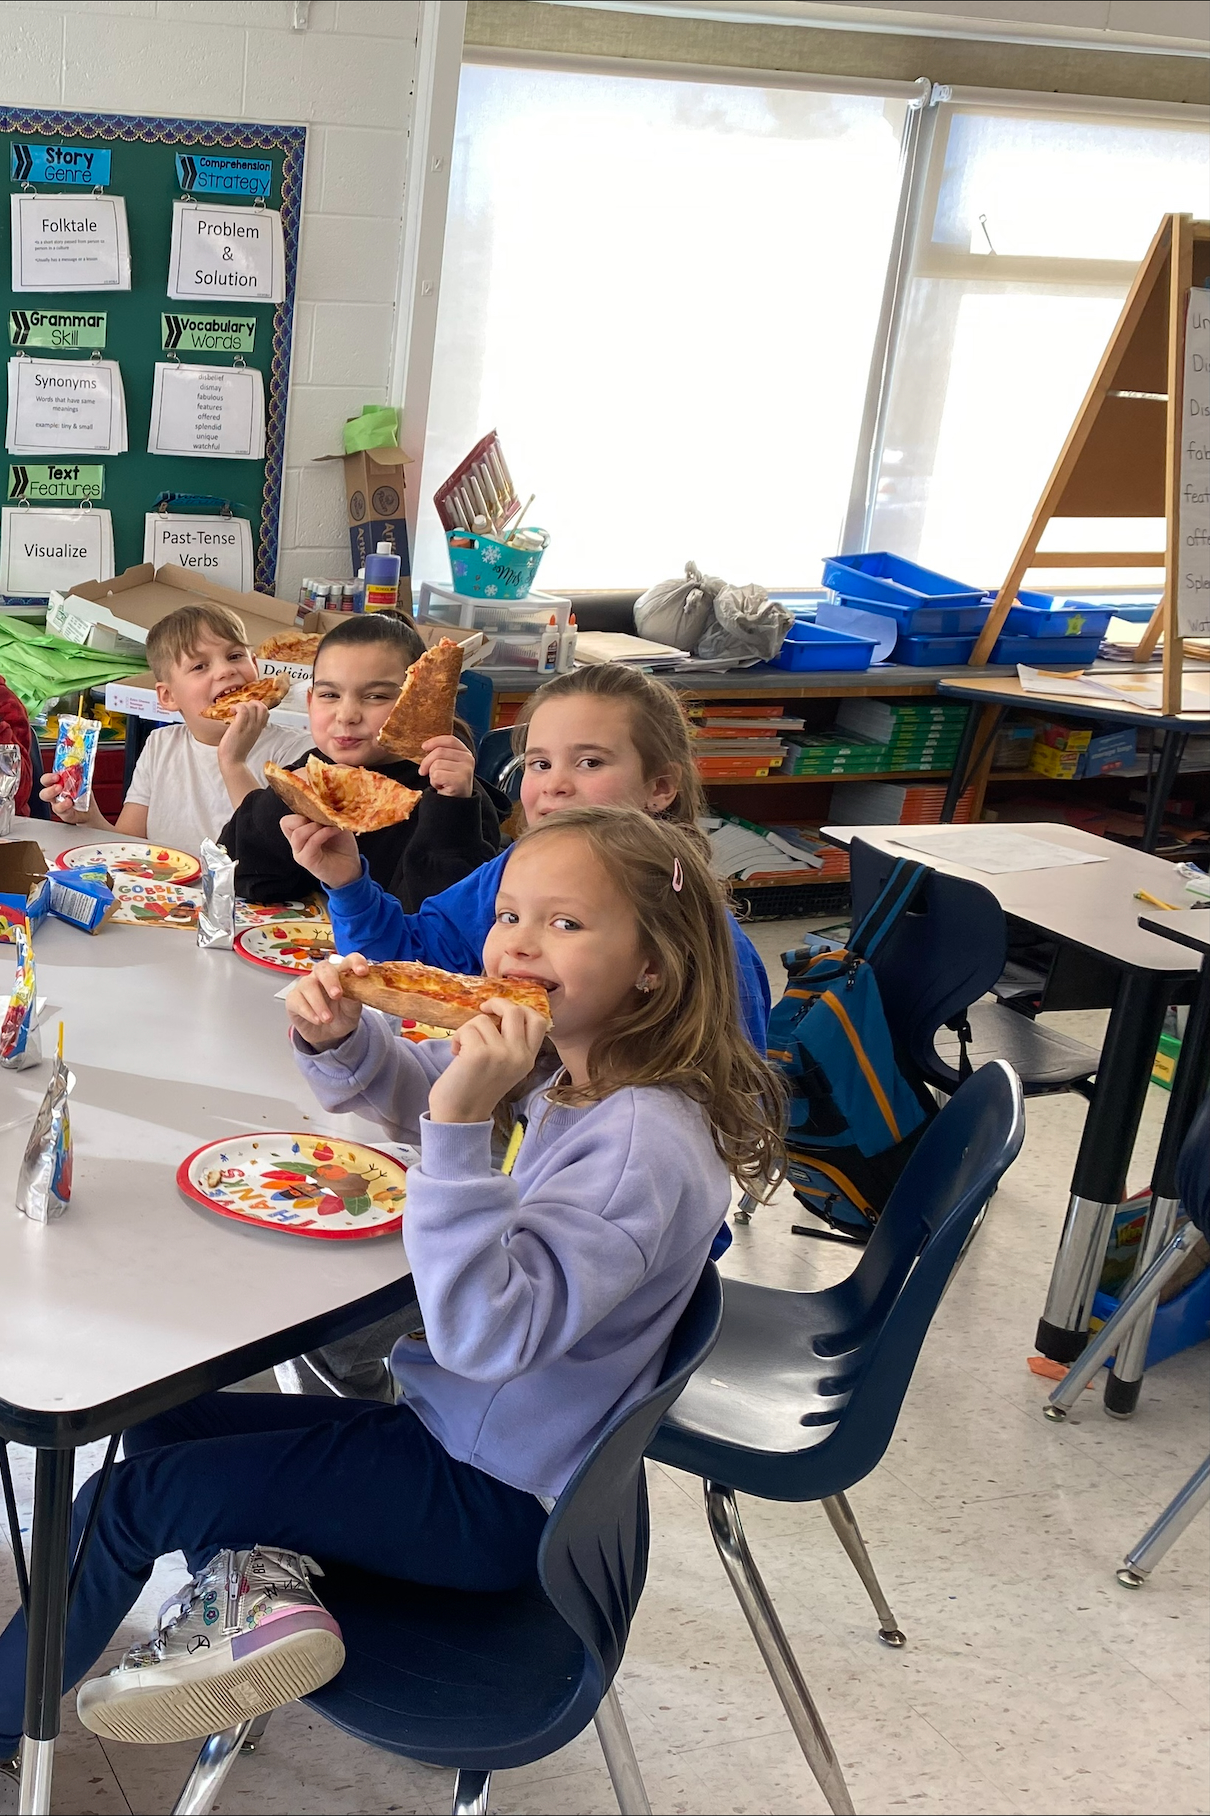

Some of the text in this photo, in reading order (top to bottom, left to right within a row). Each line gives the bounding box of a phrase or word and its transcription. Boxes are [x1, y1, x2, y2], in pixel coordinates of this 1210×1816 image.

[46, 147, 94, 169] Story
[200, 157, 270, 172] Comprehension
[44, 166, 92, 183] Genre
[198, 171, 270, 193] Strategy
[42, 217, 97, 232] Folktale
[198, 220, 260, 239] Problem
[222, 246, 233, 261] &
[194, 270, 258, 287] Solution
[30, 311, 105, 328] Grammar
[181, 318, 255, 336] Vocabulary
[51, 329, 79, 346] Skill
[191, 333, 242, 349] Words
[34, 374, 97, 391] Synonyms
[200, 384, 222, 392] dismay
[197, 393, 224, 401] fabulous
[197, 403, 222, 411] features
[47, 466, 80, 480] Text
[30, 481, 100, 497] Features
[162, 530, 236, 545] Past-Tense
[24, 543, 87, 559] Visualize
[179, 552, 218, 567] Verbs
[118, 884, 184, 895] GOBBLE
[118, 894, 186, 903] GOBBLE
